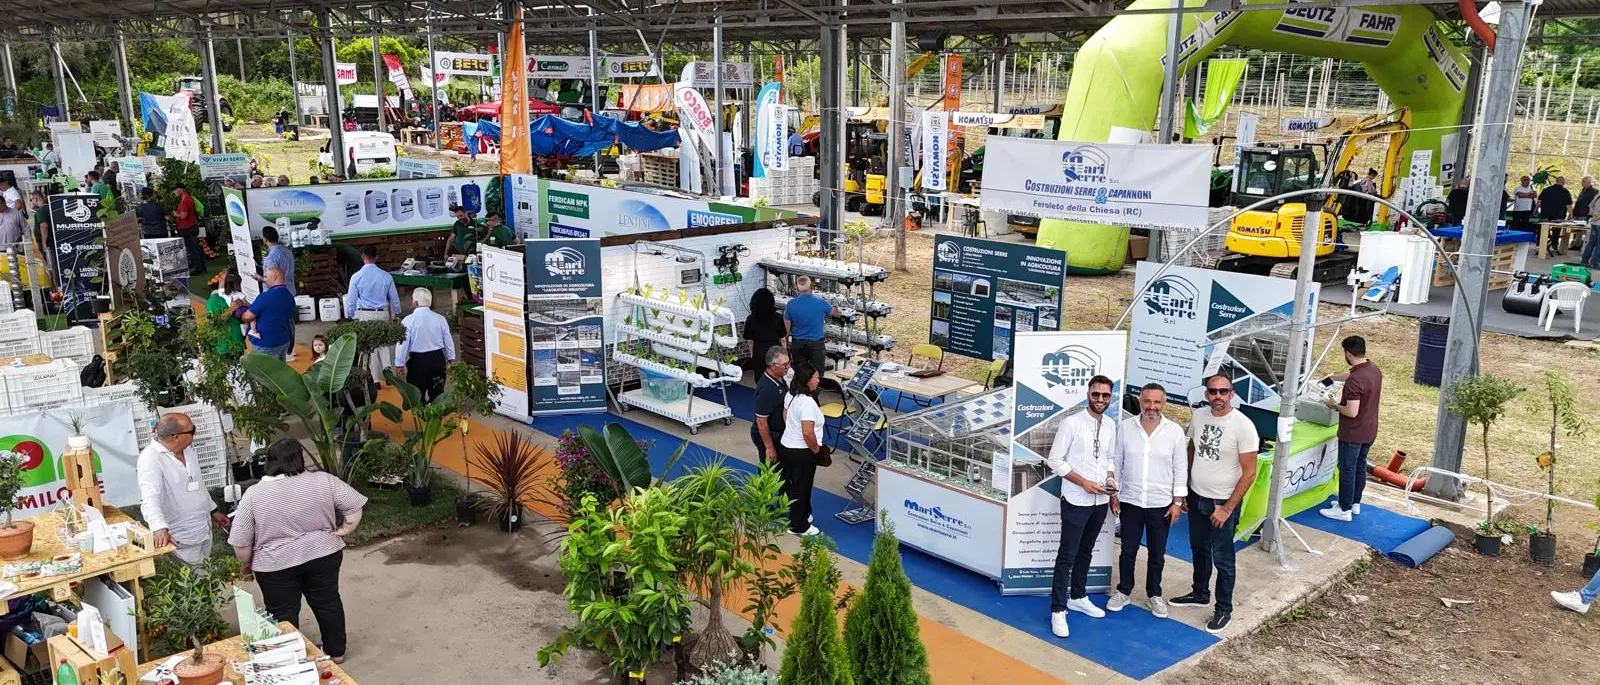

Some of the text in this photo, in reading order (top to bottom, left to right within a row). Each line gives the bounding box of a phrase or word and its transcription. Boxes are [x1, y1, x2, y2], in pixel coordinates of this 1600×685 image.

[1359, 13, 1396, 31] FAHR
[336, 69, 355, 80] SAME
[1008, 106, 1041, 115] KOMATSU
[958, 115, 994, 125] KOMATSU
[1287, 119, 1318, 131] KOMATSU
[1074, 186, 1097, 197] SERRE
[1095, 187, 1108, 205] &
[1108, 189, 1152, 200] CAPANNONI
[1033, 200, 1142, 218] Feroleto della Chiesa (RC)
[1236, 225, 1271, 235] KOMATSU
[1211, 302, 1247, 313] Costruzioni
[1218, 310, 1237, 320] Serre
[1017, 403, 1054, 412] Costruzioni
